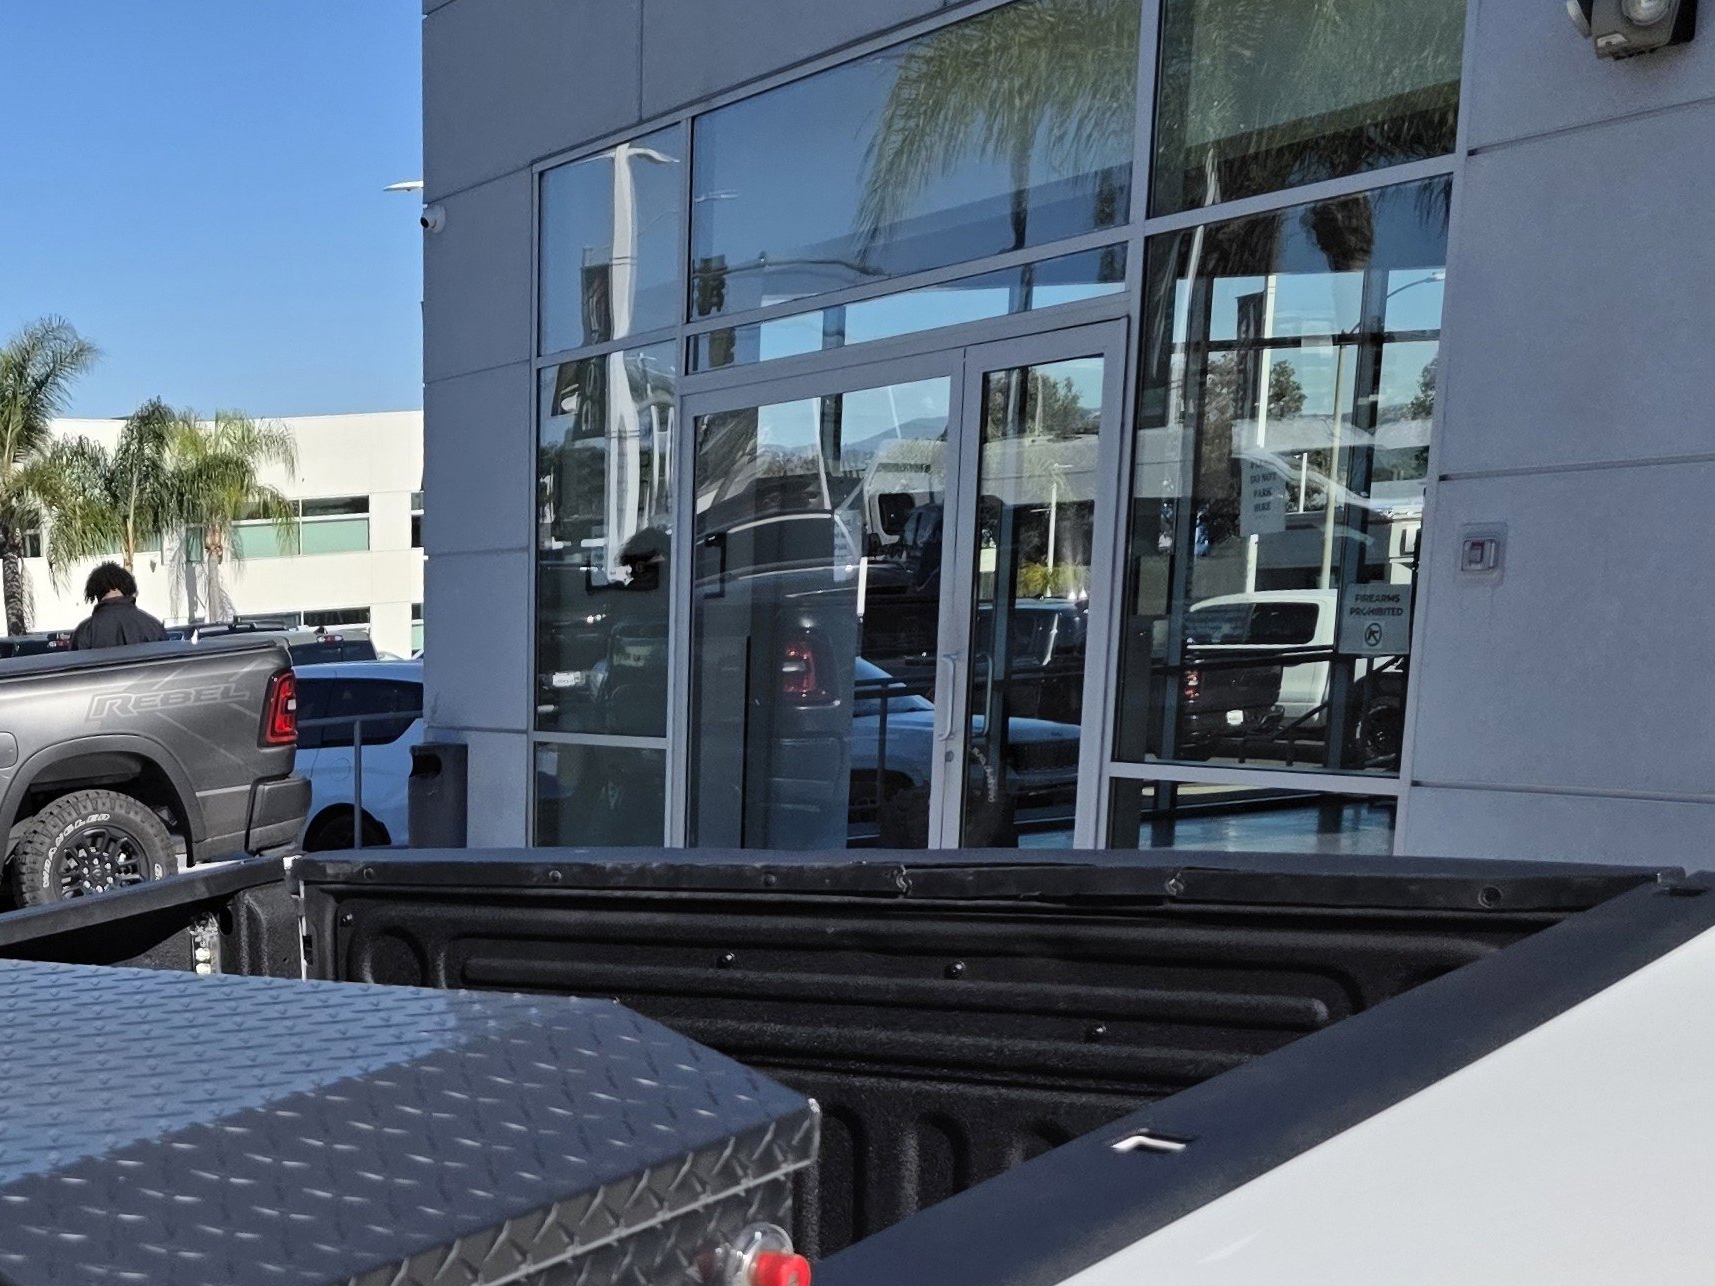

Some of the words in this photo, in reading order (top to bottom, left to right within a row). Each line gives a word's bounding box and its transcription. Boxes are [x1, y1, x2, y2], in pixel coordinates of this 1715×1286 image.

[1355, 593, 1401, 603] FIREARMS
[1349, 606, 1404, 616] PROHIBITED
[89, 683, 250, 719] REBEL
